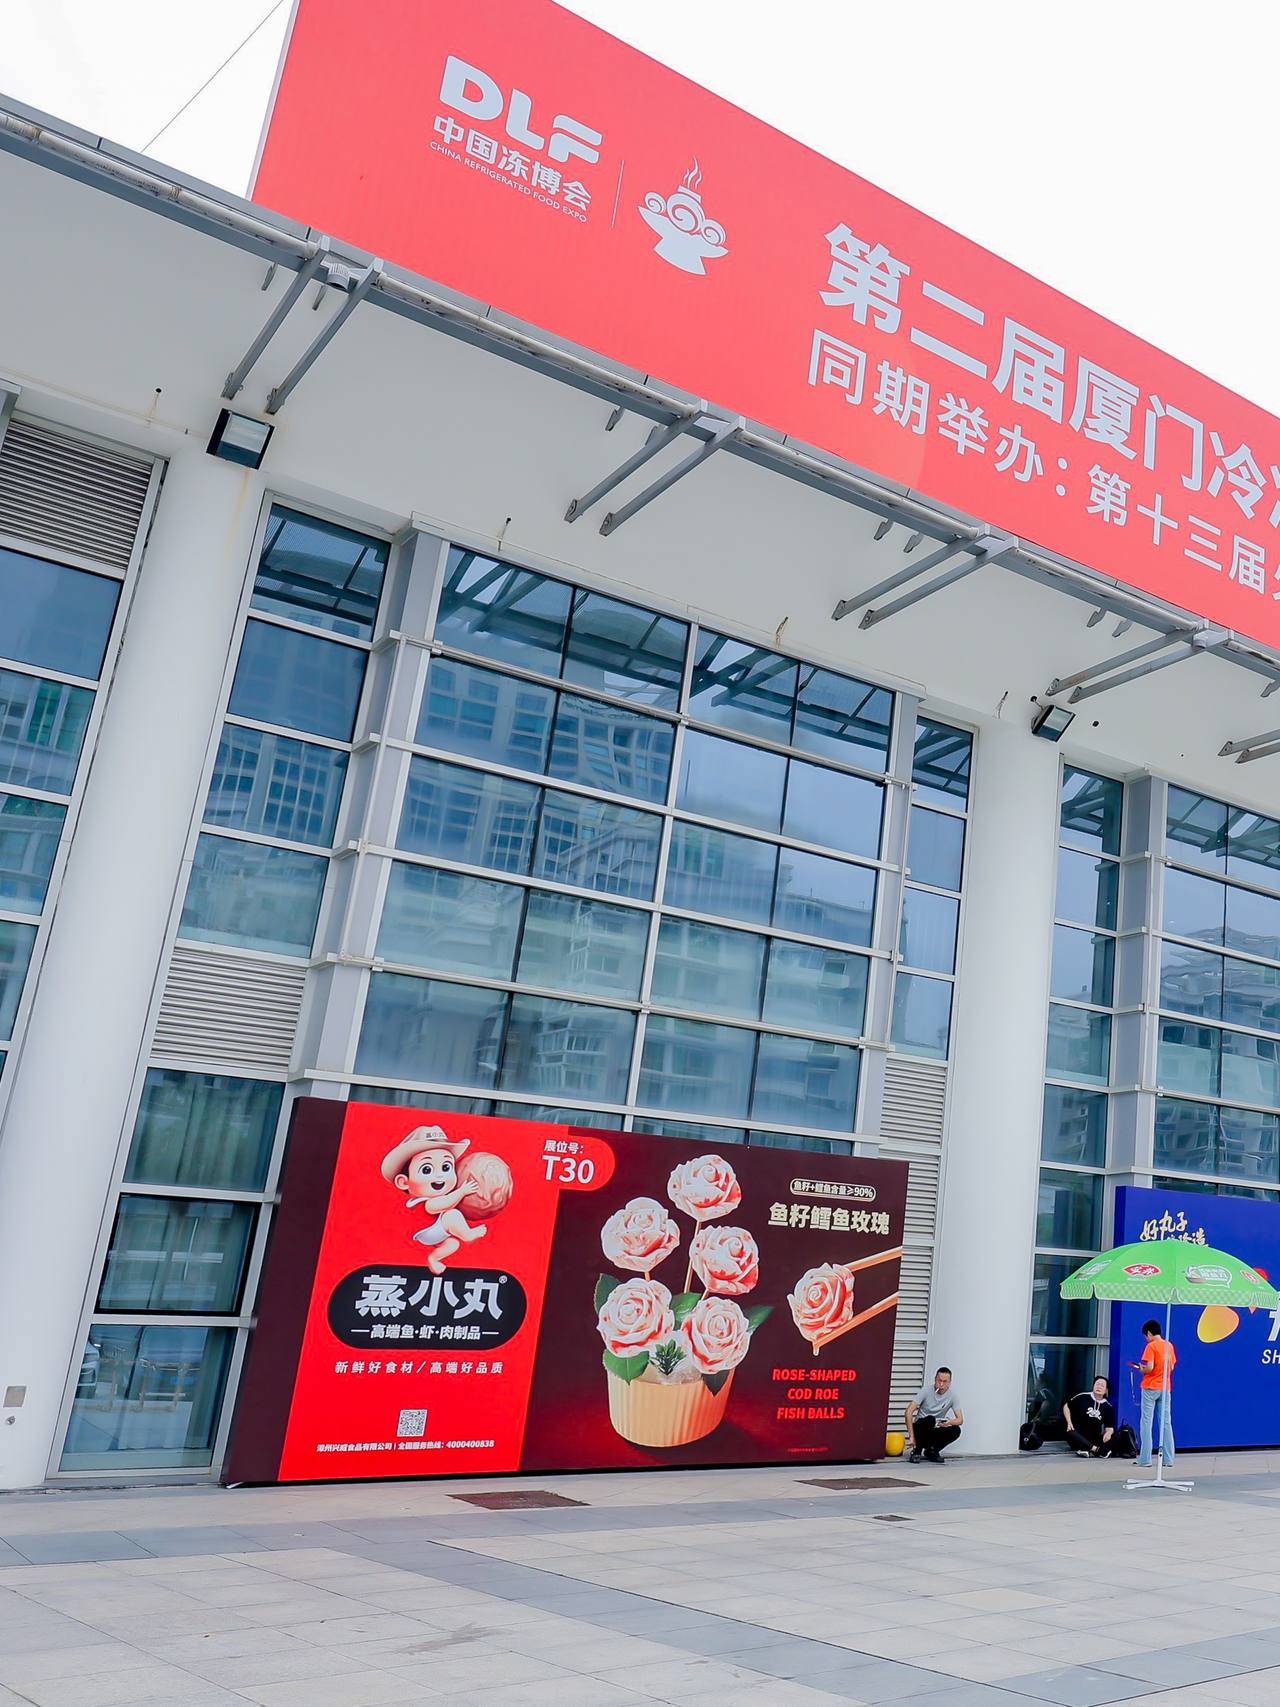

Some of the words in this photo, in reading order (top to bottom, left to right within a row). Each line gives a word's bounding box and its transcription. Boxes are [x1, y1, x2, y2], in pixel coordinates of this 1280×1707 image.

[439, 55, 602, 164] DLF
[433, 115, 592, 211] 中国冻博会
[430, 141, 462, 162] CHINA
[464, 158, 531, 196] REFRIGERATED
[533, 190, 561, 212] FOOD
[562, 204, 587, 223] EXPO
[542, 1155, 594, 1184] T30
[768, 1202, 889, 1235] 鱼籽鳕鱼玫瑰
[355, 1274, 503, 1320] 蒸小丸
[772, 1369, 857, 1381] ROSE-SHAPED
[787, 1388, 812, 1400] COD
[815, 1388, 839, 1400] ROE
[777, 1407, 805, 1419] FISH
[808, 1407, 845, 1419] BALLS
